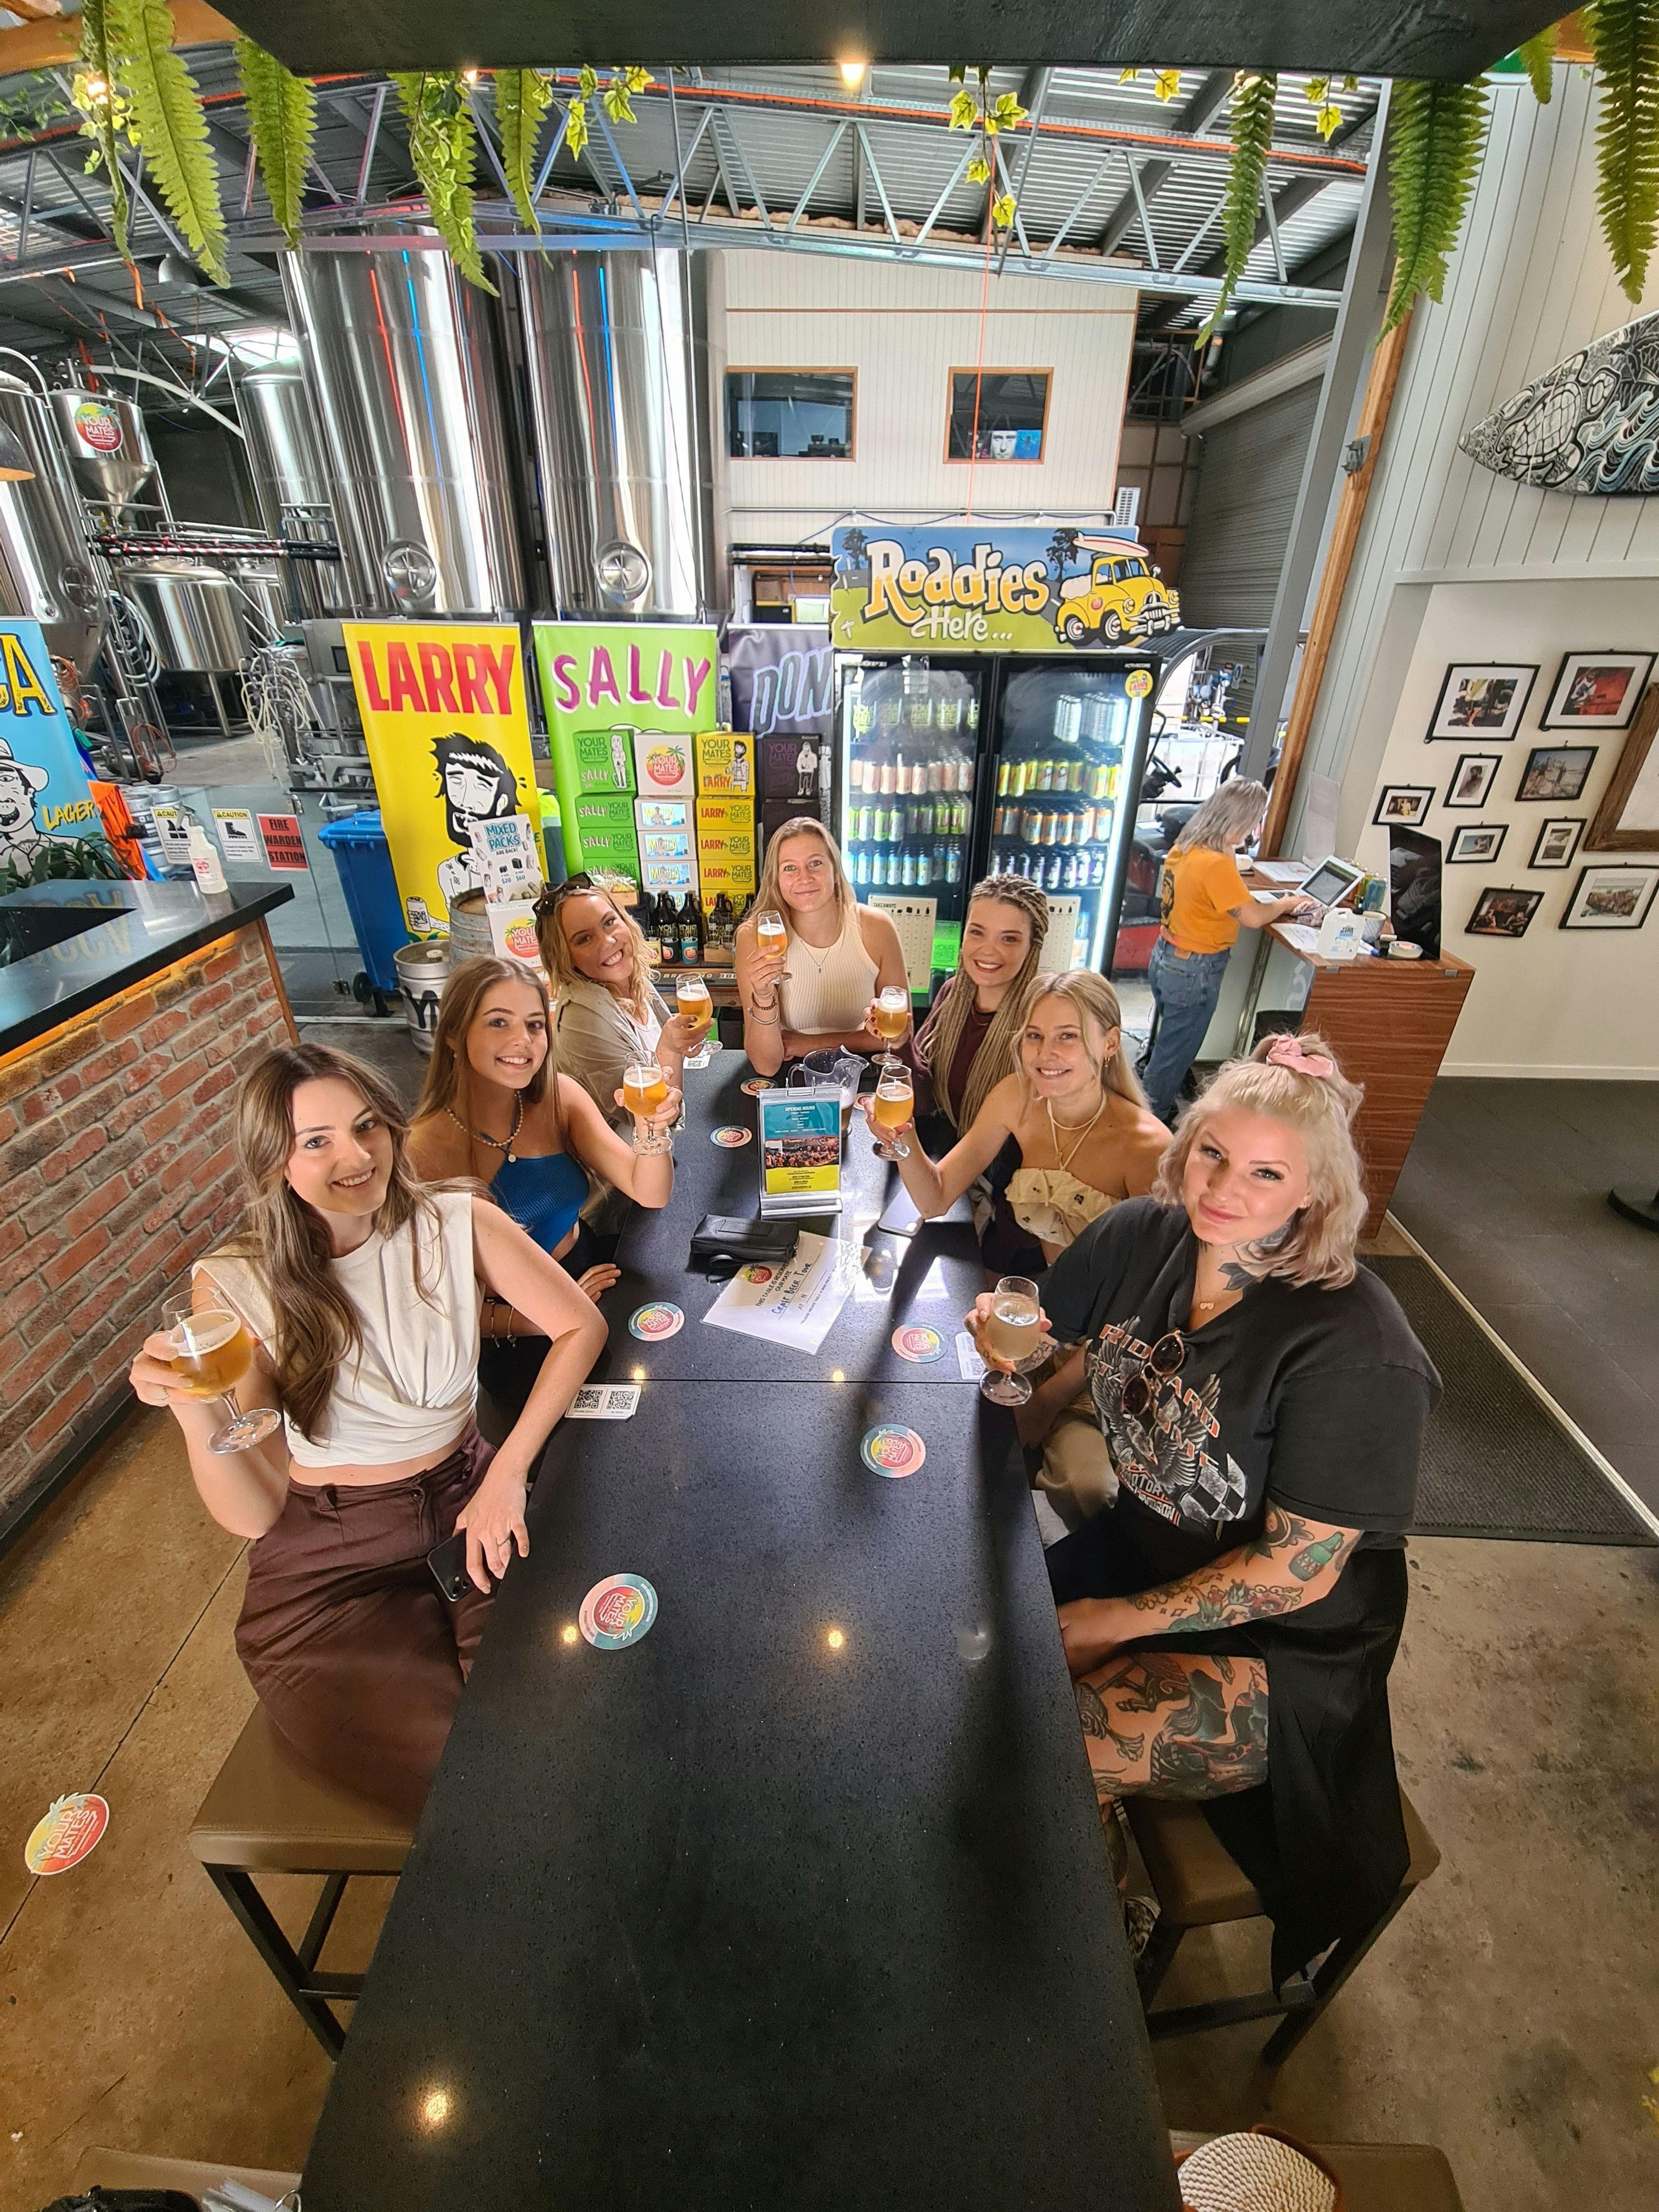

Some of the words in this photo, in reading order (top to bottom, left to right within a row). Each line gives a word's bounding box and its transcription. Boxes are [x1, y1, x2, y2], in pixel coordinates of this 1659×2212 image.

[83, 416, 111, 426] YOUR
[85, 426, 115, 436] MATES
[863, 539, 1049, 627] Roadies
[358, 641, 515, 714] LARRY
[552, 644, 711, 718] SALLY
[749, 646, 832, 738] DON
[577, 737, 607, 748] YOUR
[702, 739, 731, 751] YOUR
[769, 743, 798, 754] YOUR
[580, 747, 608, 757] MATES
[703, 749, 731, 759] MATES
[653, 755, 678, 764] YOUR
[653, 763, 679, 772] MATES
[582, 769, 609, 782] SALLY
[703, 775, 731, 788] LARRY
[42, 799, 96, 831] LAGER
[579, 805, 607, 817] SALLY
[701, 808, 725, 817] LARRY
[269, 819, 288, 829] FIRE
[484, 822, 517, 837] MIXED
[264, 835, 303, 845] WARDEN
[488, 834, 520, 850] PACKS
[583, 836, 611, 848] SALLY
[701, 840, 724, 849] LARRY
[269, 851, 306, 862] STATION
[704, 868, 727, 878] LARRY
[514, 935, 538, 945] MATE
[755, 1296, 765, 1307] THIS
[763, 1284, 775, 1299] TABLE
[775, 1261, 791, 1283] RESERVED
[775, 1281, 784, 1291] OUR
[782, 1270, 792, 1284] MATE
[642, 1311, 662, 1323] YOUR
[647, 1314, 668, 1329] MATES
[1099, 1324, 1153, 1359] RID
[1163, 1374, 1220, 1438] ARD
[879, 1438, 894, 1457] YOUR
[889, 1441, 905, 1461] MATES
[605, 1595, 627, 1625] MATES
[614, 1598, 637, 1627] YOUR
[37, 1810, 81, 1857] YOUR
[53, 1809, 89, 1859] MATES
